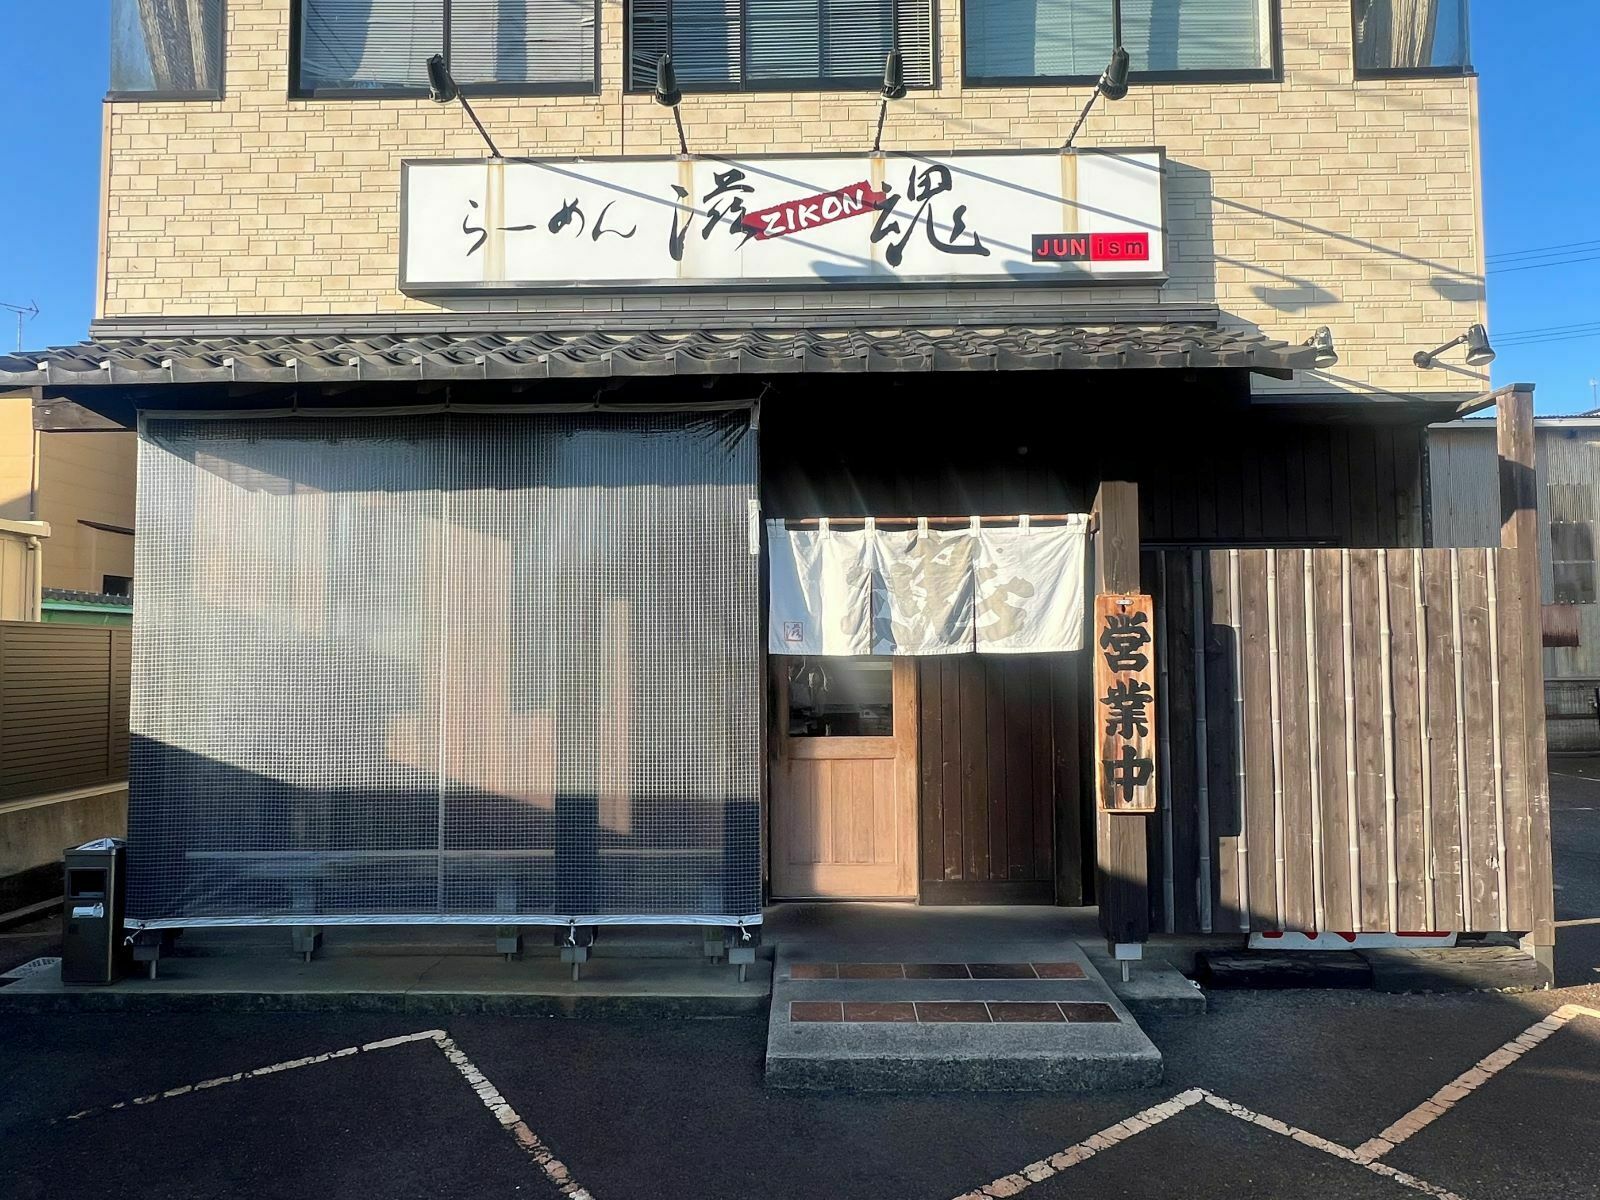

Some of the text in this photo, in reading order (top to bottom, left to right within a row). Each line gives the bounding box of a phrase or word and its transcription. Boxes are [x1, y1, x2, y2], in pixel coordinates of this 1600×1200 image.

[462, 198, 637, 257] らーめん
[761, 190, 864, 237] ZIKON
[1099, 611, 1154, 803] 営業中
